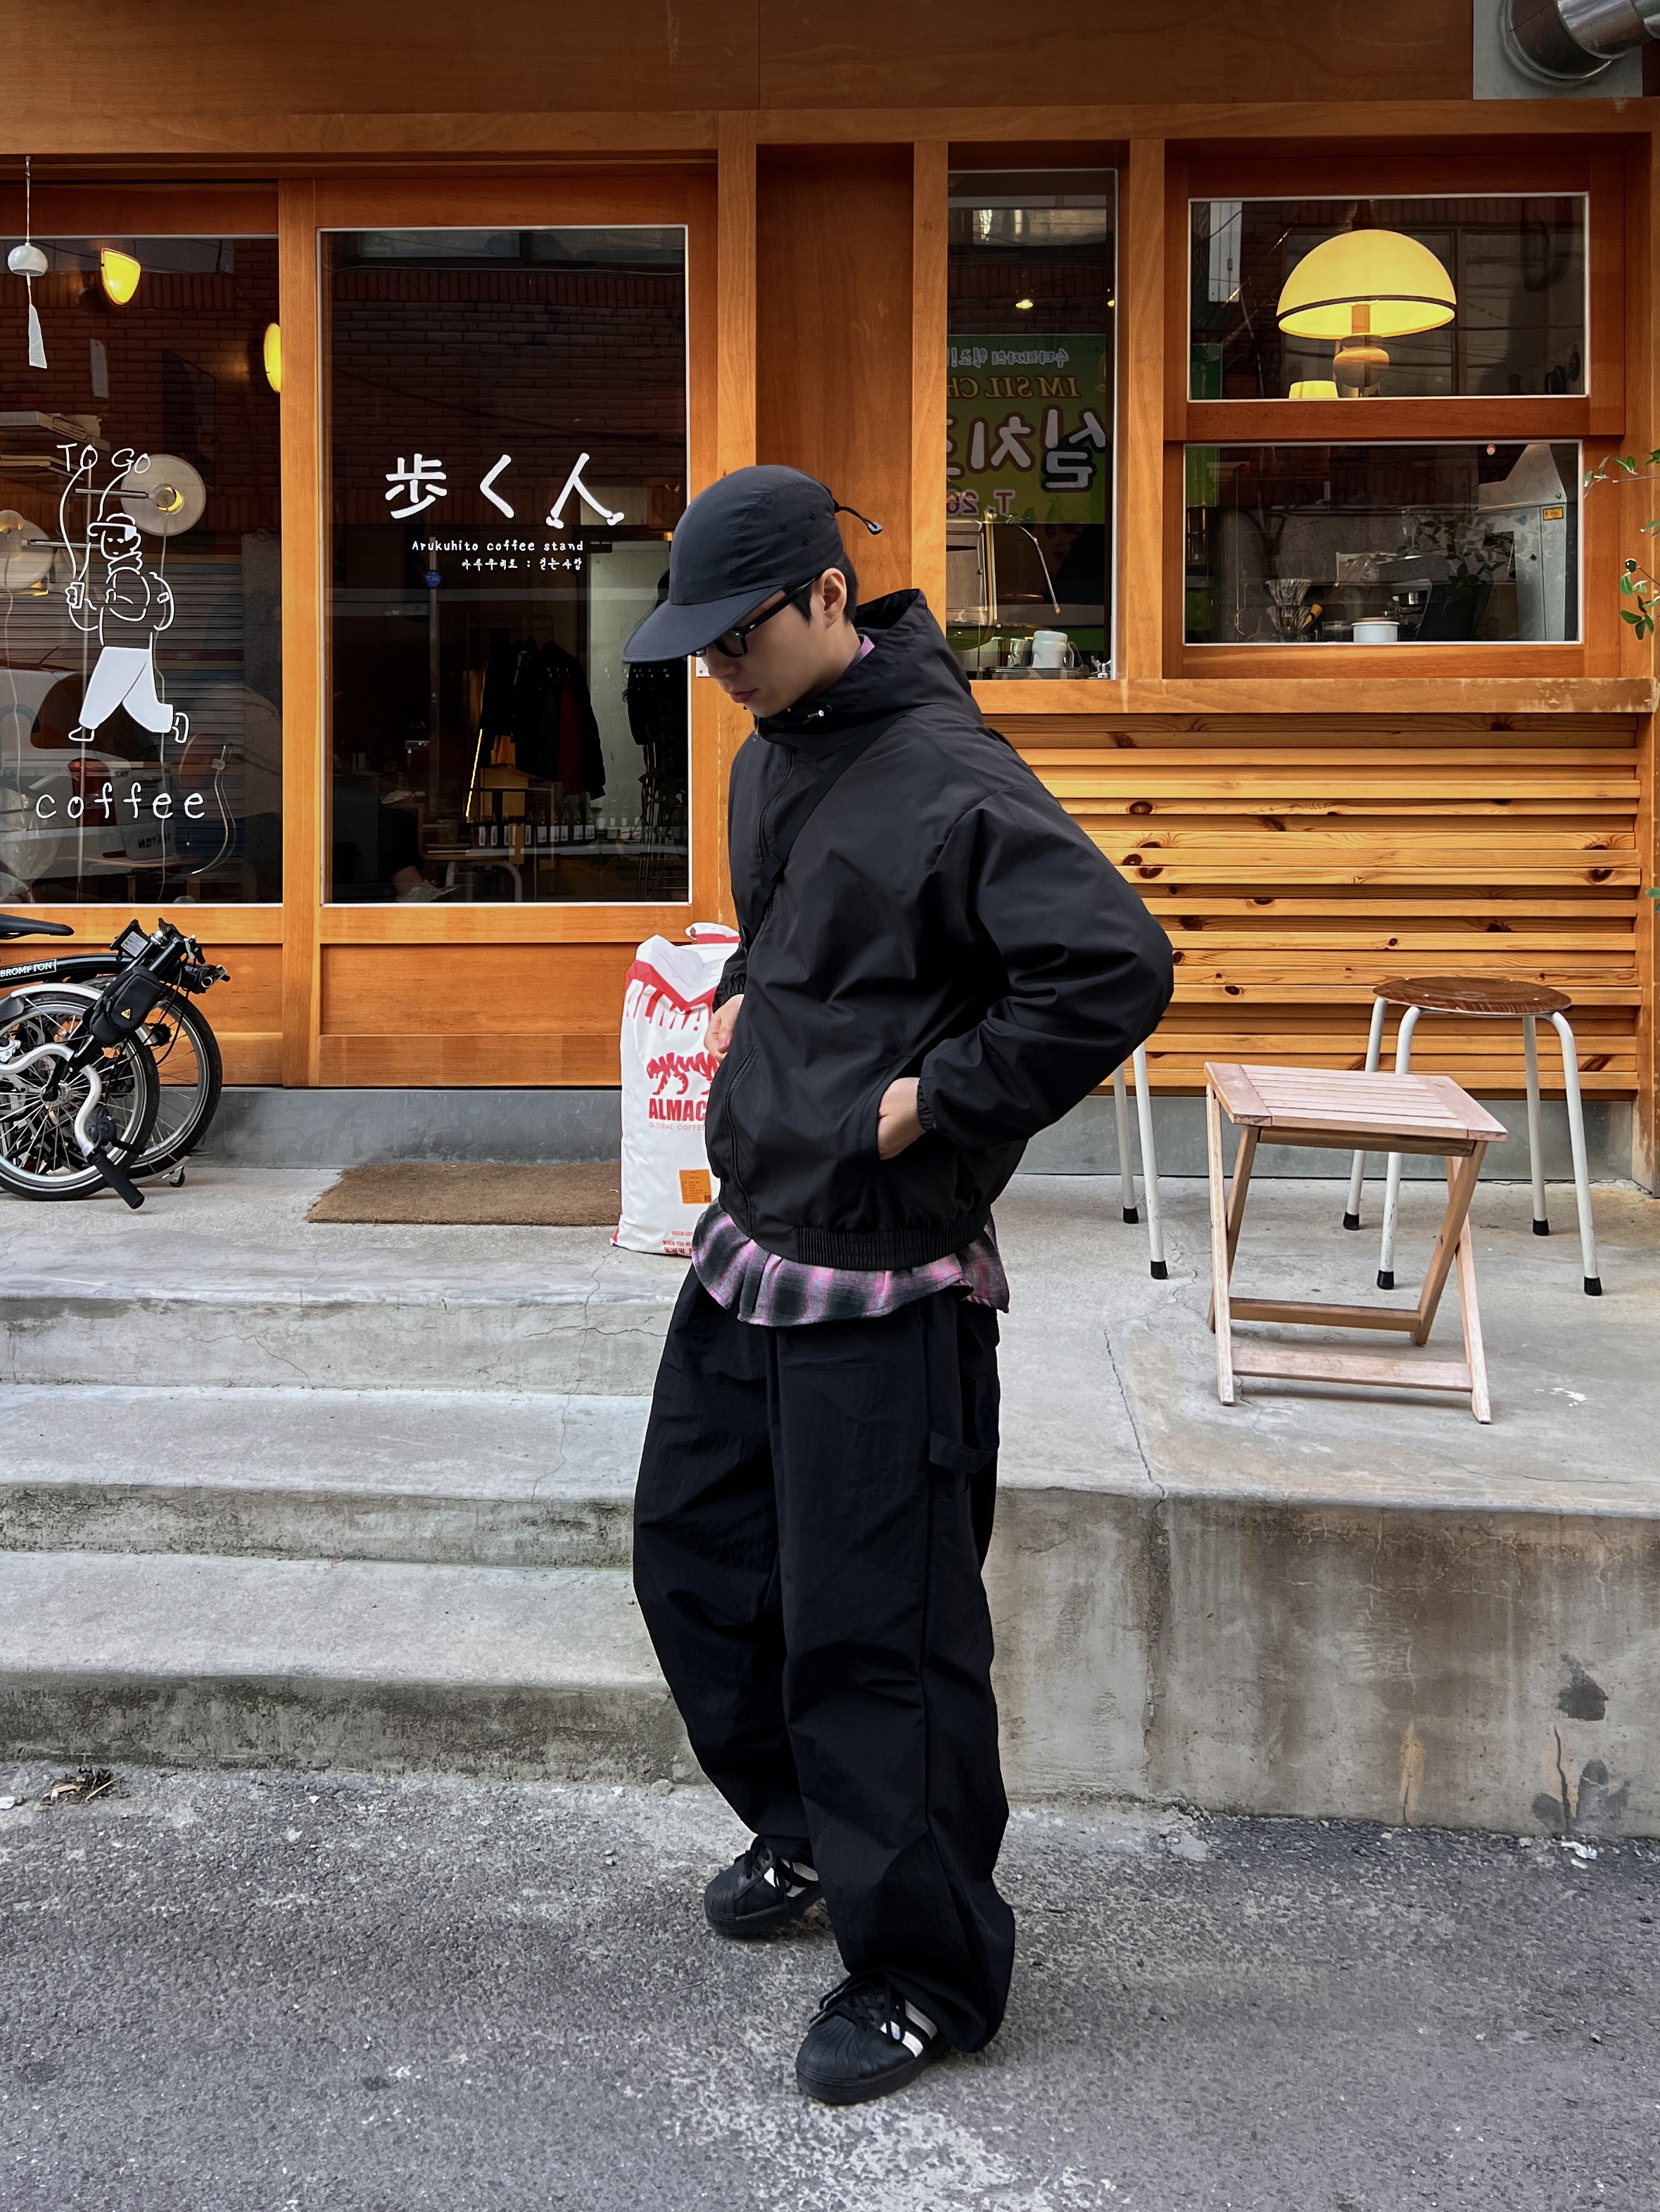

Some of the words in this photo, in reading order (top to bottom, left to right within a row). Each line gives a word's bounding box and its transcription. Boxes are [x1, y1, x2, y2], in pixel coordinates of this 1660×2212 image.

[56, 443, 99, 472] TO
[385, 452, 625, 529] 歩く人
[412, 540, 479, 552] Arukuhito
[486, 539, 536, 552] coffee
[543, 540, 584, 552] stand
[35, 782, 205, 820] coffee
[0, 961, 53, 978] BROMPTON
[649, 1098, 707, 1121] ALMAC
[648, 1121, 674, 1131] GLOBAL
